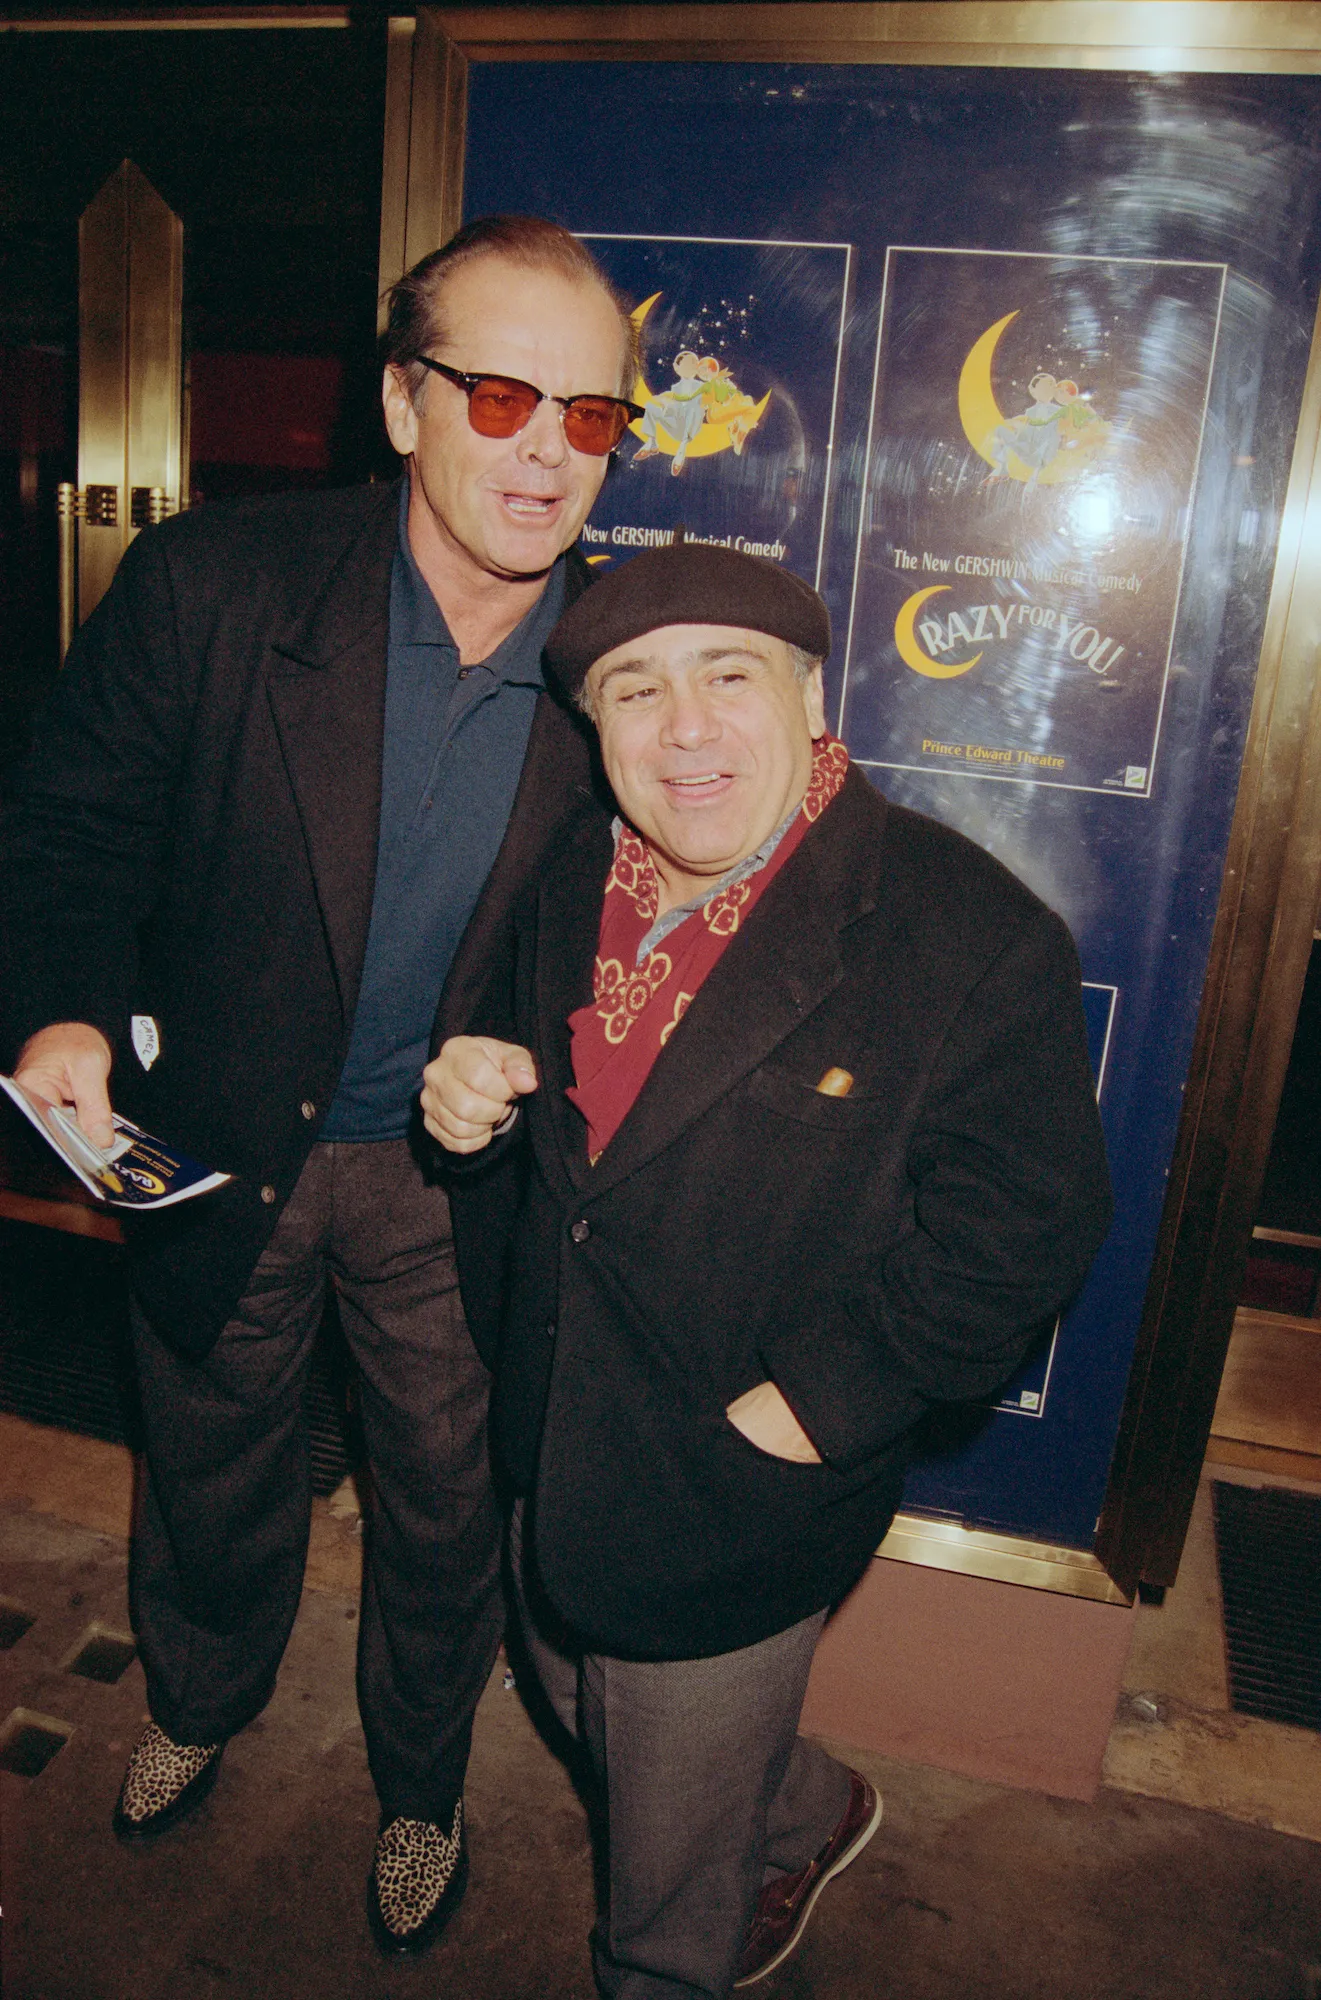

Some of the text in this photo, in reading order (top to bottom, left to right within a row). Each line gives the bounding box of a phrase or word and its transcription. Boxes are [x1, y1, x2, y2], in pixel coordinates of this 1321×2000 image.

[582, 524, 608, 544] New
[735, 536, 786, 561] Comedy
[894, 549, 918, 570] The
[922, 552, 950, 573] New
[954, 554, 1030, 580] GERSHWIN
[1086, 571, 1144, 595] Comedy
[1017, 604, 1057, 630] FOR
[1055, 613, 1126, 674] YOU
[921, 739, 962, 757] Prince
[965, 744, 1012, 762] Edward
[1016, 749, 1065, 769] Theatre
